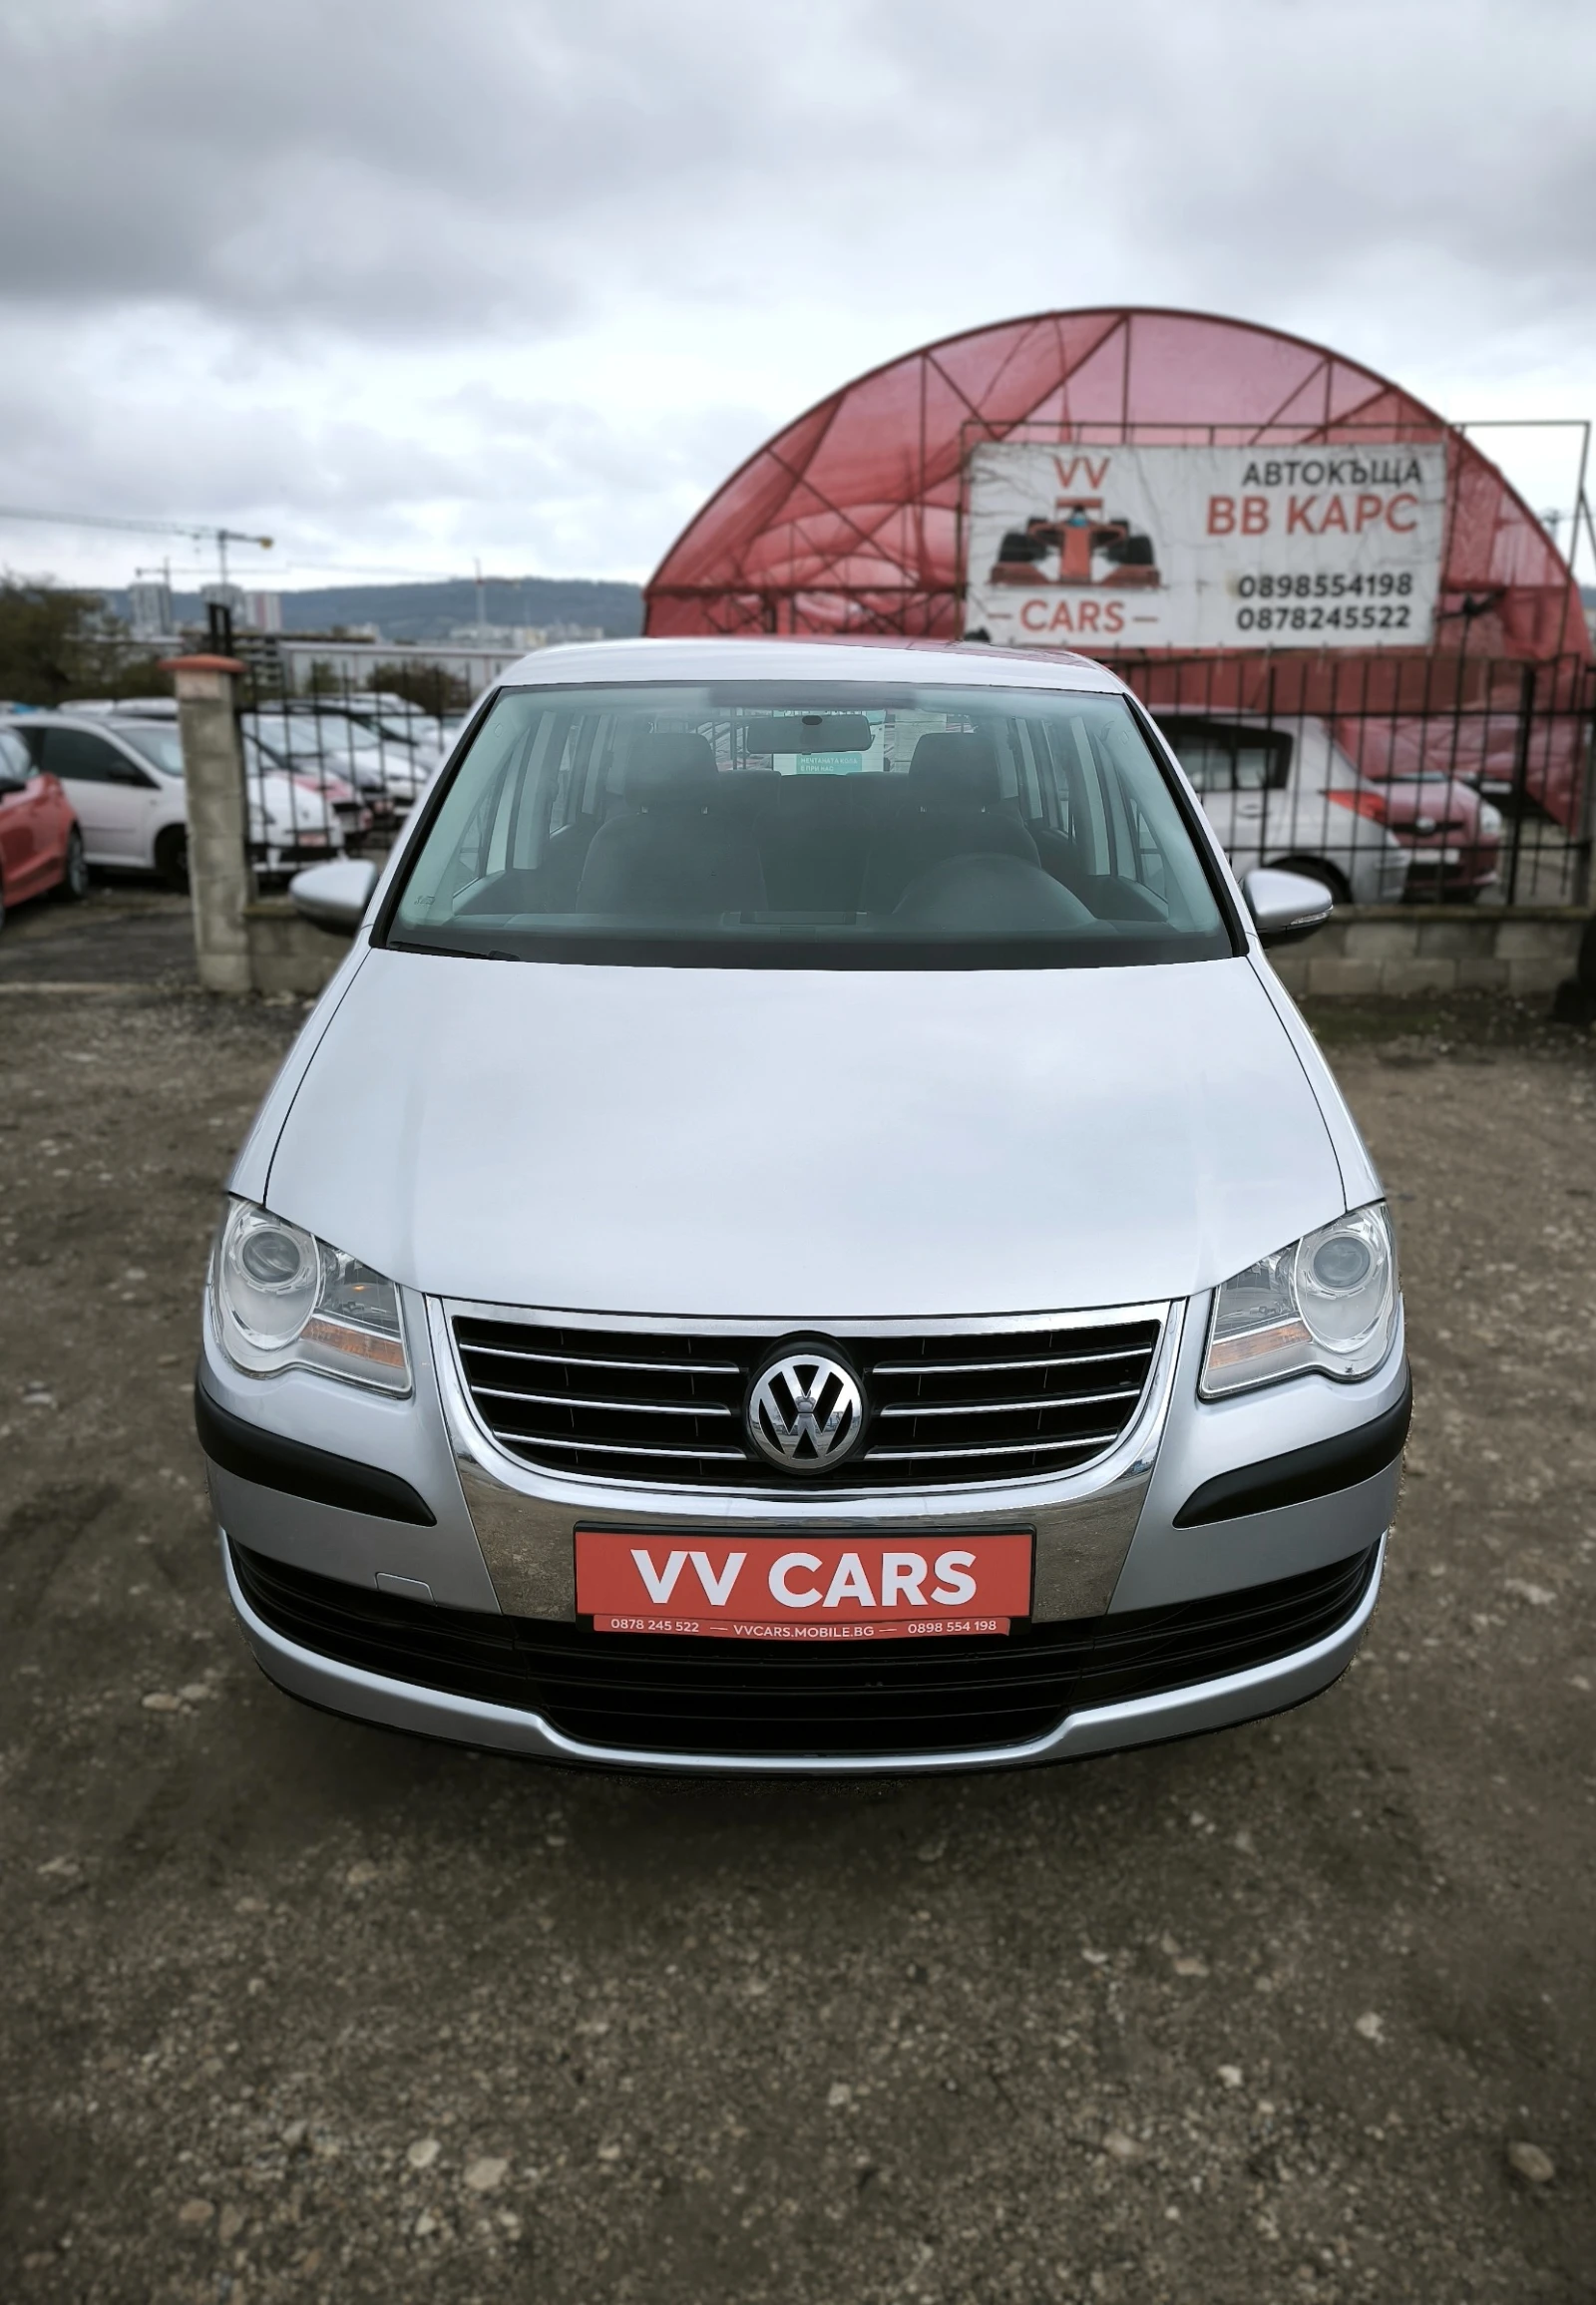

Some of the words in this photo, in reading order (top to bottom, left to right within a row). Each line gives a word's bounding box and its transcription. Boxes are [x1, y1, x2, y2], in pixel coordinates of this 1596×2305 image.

[1053, 456, 1111, 490] VV
[1241, 458, 1424, 489] АВТОКЪЩА
[1206, 497, 1270, 537] ВВ
[1287, 493, 1419, 536] КАРС
[1237, 574, 1413, 598] 0898554198
[1019, 599, 1125, 633] CARS
[1236, 605, 1411, 631] 0878245522
[630, 1548, 747, 1607] VV
[768, 1550, 978, 1609] CARS
[610, 1618, 644, 1630] 0878
[647, 1620, 672, 1631] 245
[675, 1621, 699, 1633] 522
[733, 1624, 875, 1639] VVCARS.MOBILE.BG
[908, 1622, 943, 1634] 0898
[947, 1621, 971, 1633] 554
[974, 1620, 997, 1631] 198
